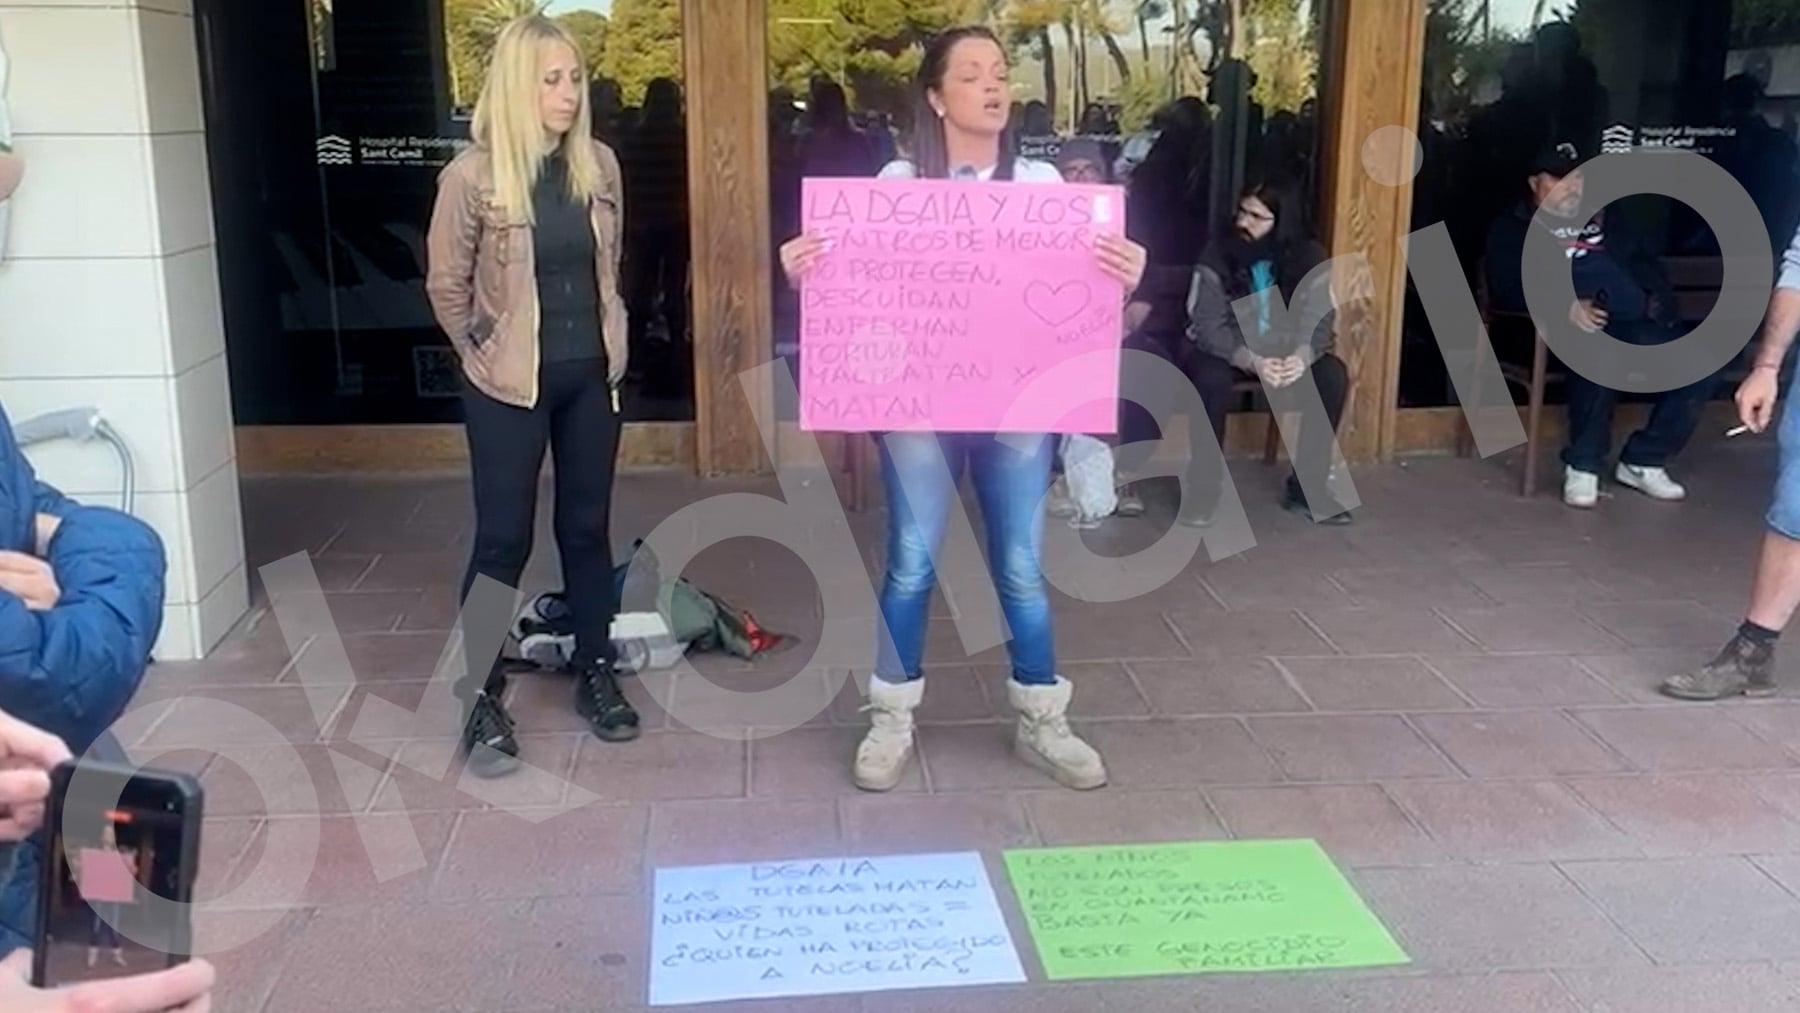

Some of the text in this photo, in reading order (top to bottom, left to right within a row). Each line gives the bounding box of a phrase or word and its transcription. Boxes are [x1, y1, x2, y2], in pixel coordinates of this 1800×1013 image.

[359, 136, 406, 148] Hospital
[360, 147, 423, 158] Sant Camil
[809, 189, 1093, 226] LA DGAIA Y LOS
[955, 228, 984, 252] DE
[996, 227, 1094, 252] MENOR
[804, 341, 942, 364] TORTURAN
[809, 396, 932, 422] MATAN
[751, 861, 880, 881] DGAIA
[663, 889, 720, 904] LAS
[748, 882, 863, 897] TUTELAS
[1028, 886, 1069, 899] NO
[775, 902, 931, 919] TUTELADAS
[714, 917, 945, 942] VIDAS ROTAS
[800, 940, 838, 954] HA
[760, 966, 785, 980] A
